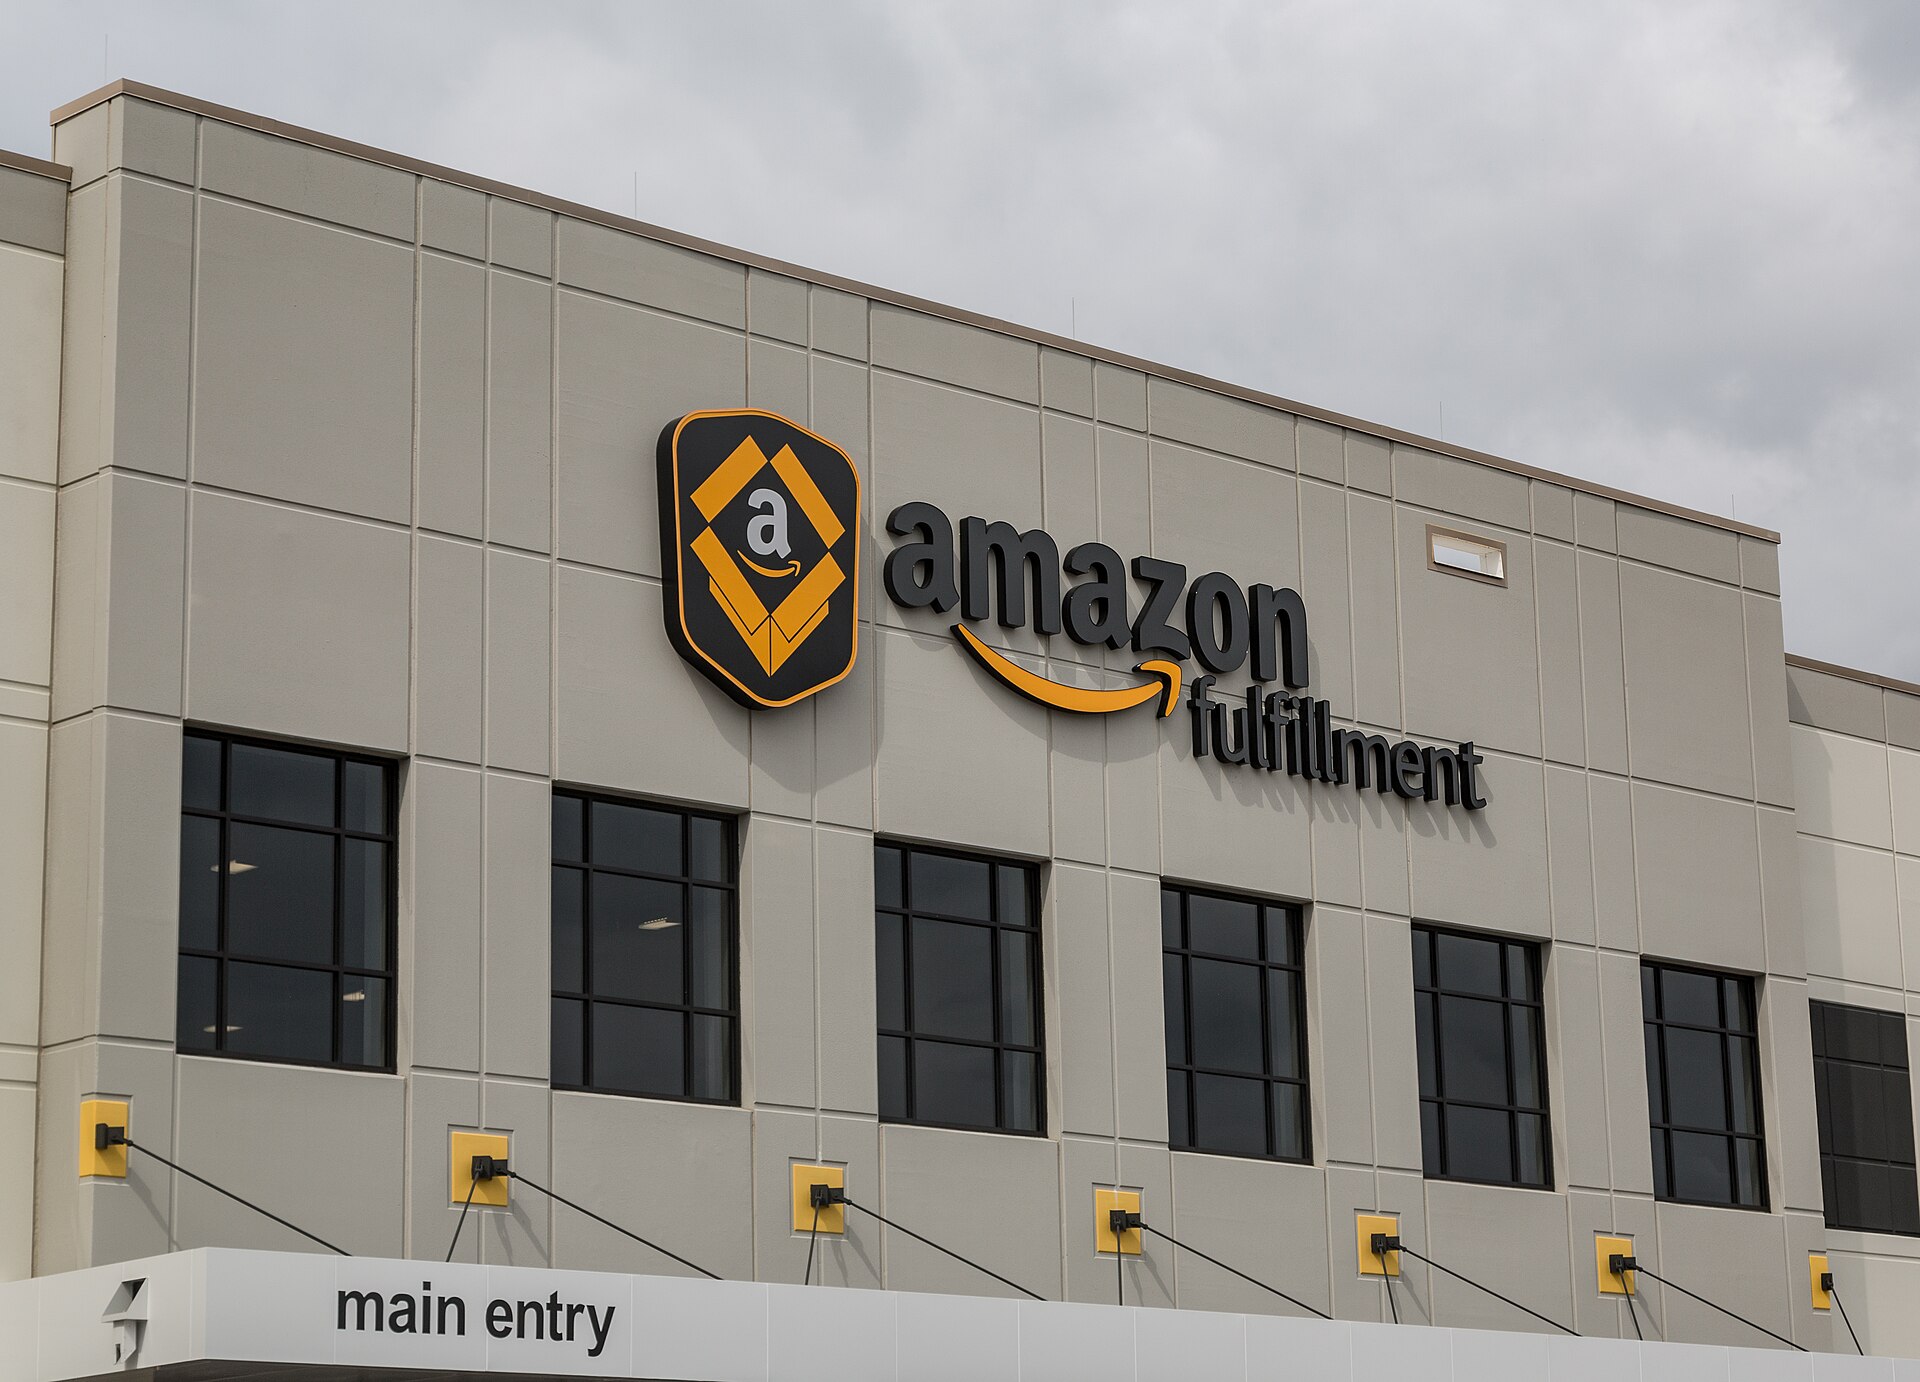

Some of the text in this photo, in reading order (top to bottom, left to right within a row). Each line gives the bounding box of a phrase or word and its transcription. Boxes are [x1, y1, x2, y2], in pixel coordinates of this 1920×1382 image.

[746, 488, 792, 557] a
[884, 501, 1309, 688] amazon
[1188, 676, 1487, 810] fulfillment
[337, 1281, 616, 1357] main entry
